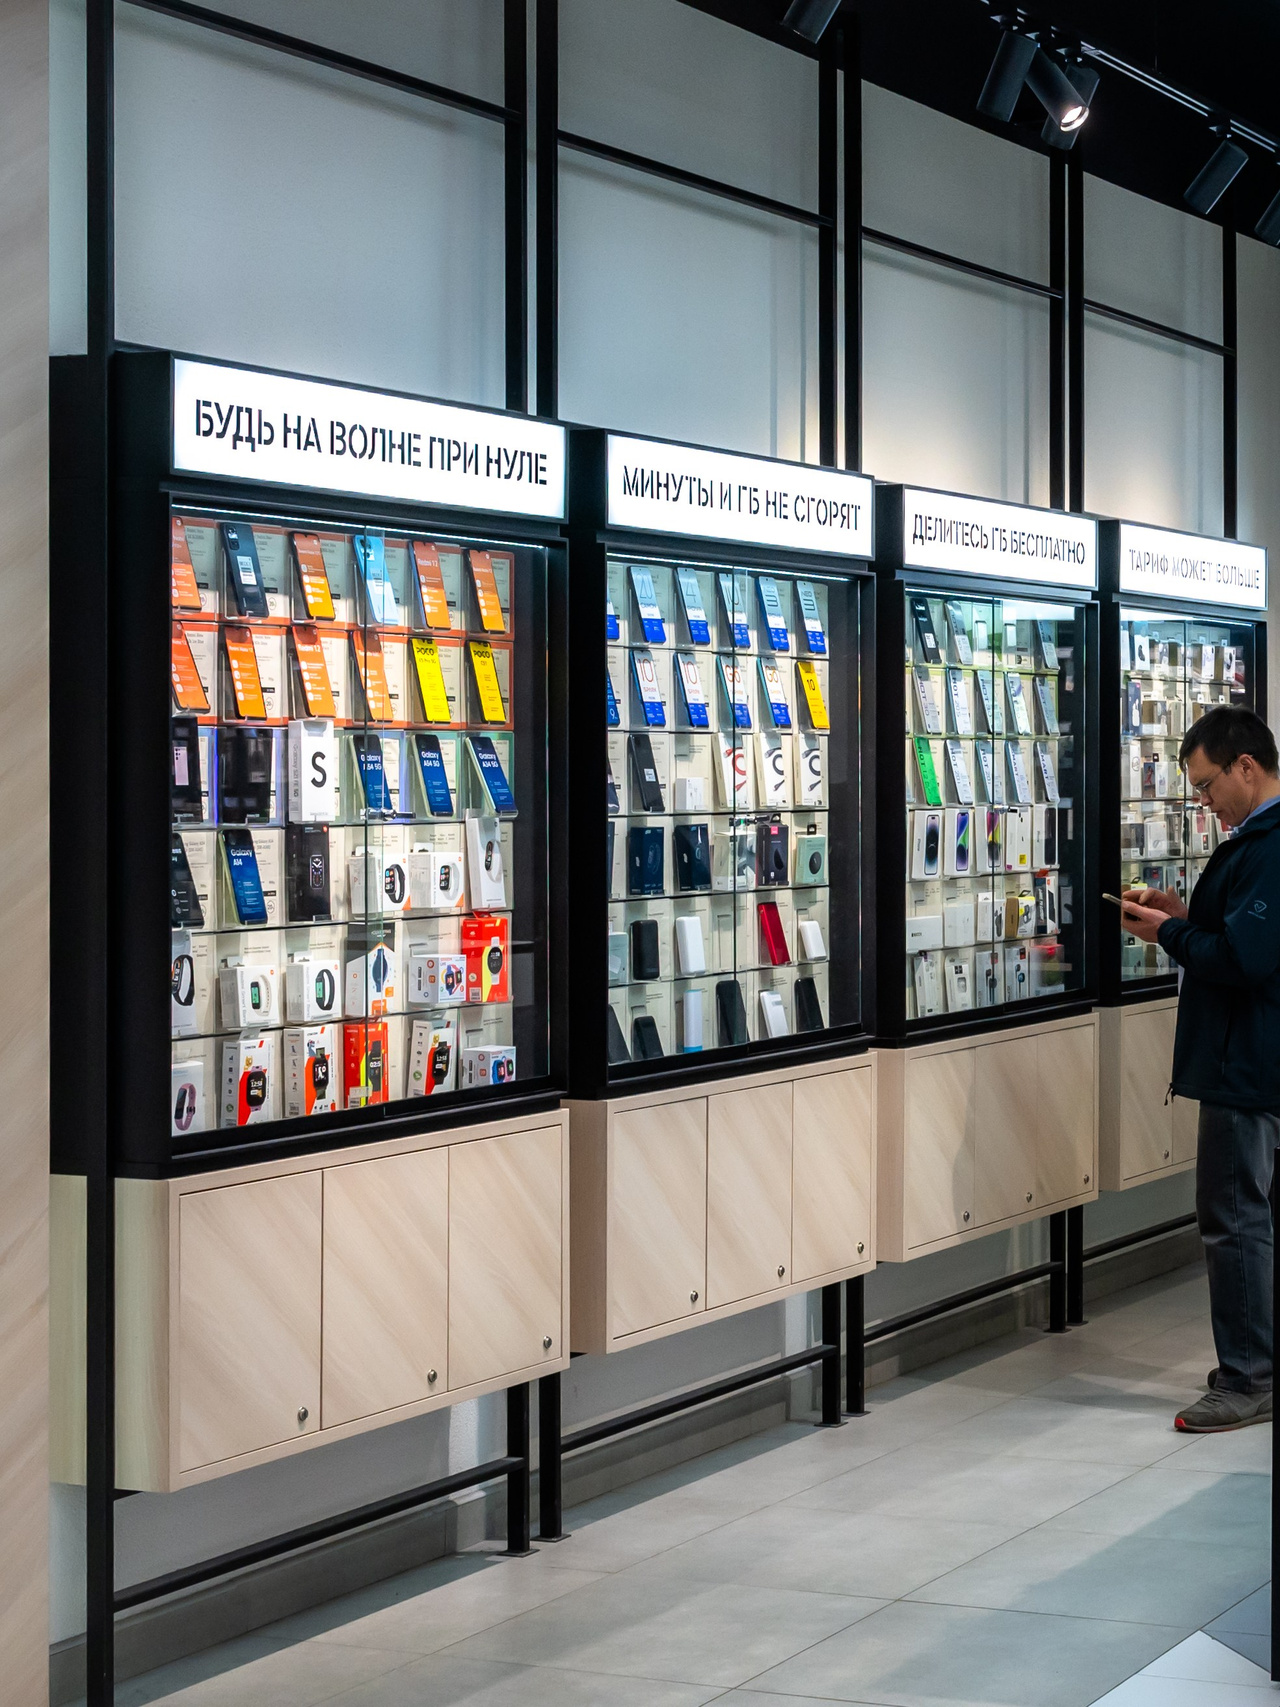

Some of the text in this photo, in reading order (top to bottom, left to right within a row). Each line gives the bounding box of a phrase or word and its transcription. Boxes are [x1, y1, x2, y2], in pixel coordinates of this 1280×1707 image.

[195, 399, 548, 486] БУДЬ НА ВОЛНЕ ПРИ НУЛЕ
[623, 465, 861, 530] МИНУТЫ И ГБ НЕ СГОРЯТ
[912, 513, 1085, 565] ДЕЛИТЕСЬ ГБ БЕСПЛАТНО
[1129, 549, 1260, 590] ТАРИФ МОЖЕТ БОЛЬШЕ
[416, 647, 435, 656] POCO
[473, 650, 491, 658] POCO
[421, 751, 439, 760] Galaxy
[478, 752, 496, 760] Galaxy
[311, 751, 327, 788] S
[230, 848, 252, 857] Galaxy
